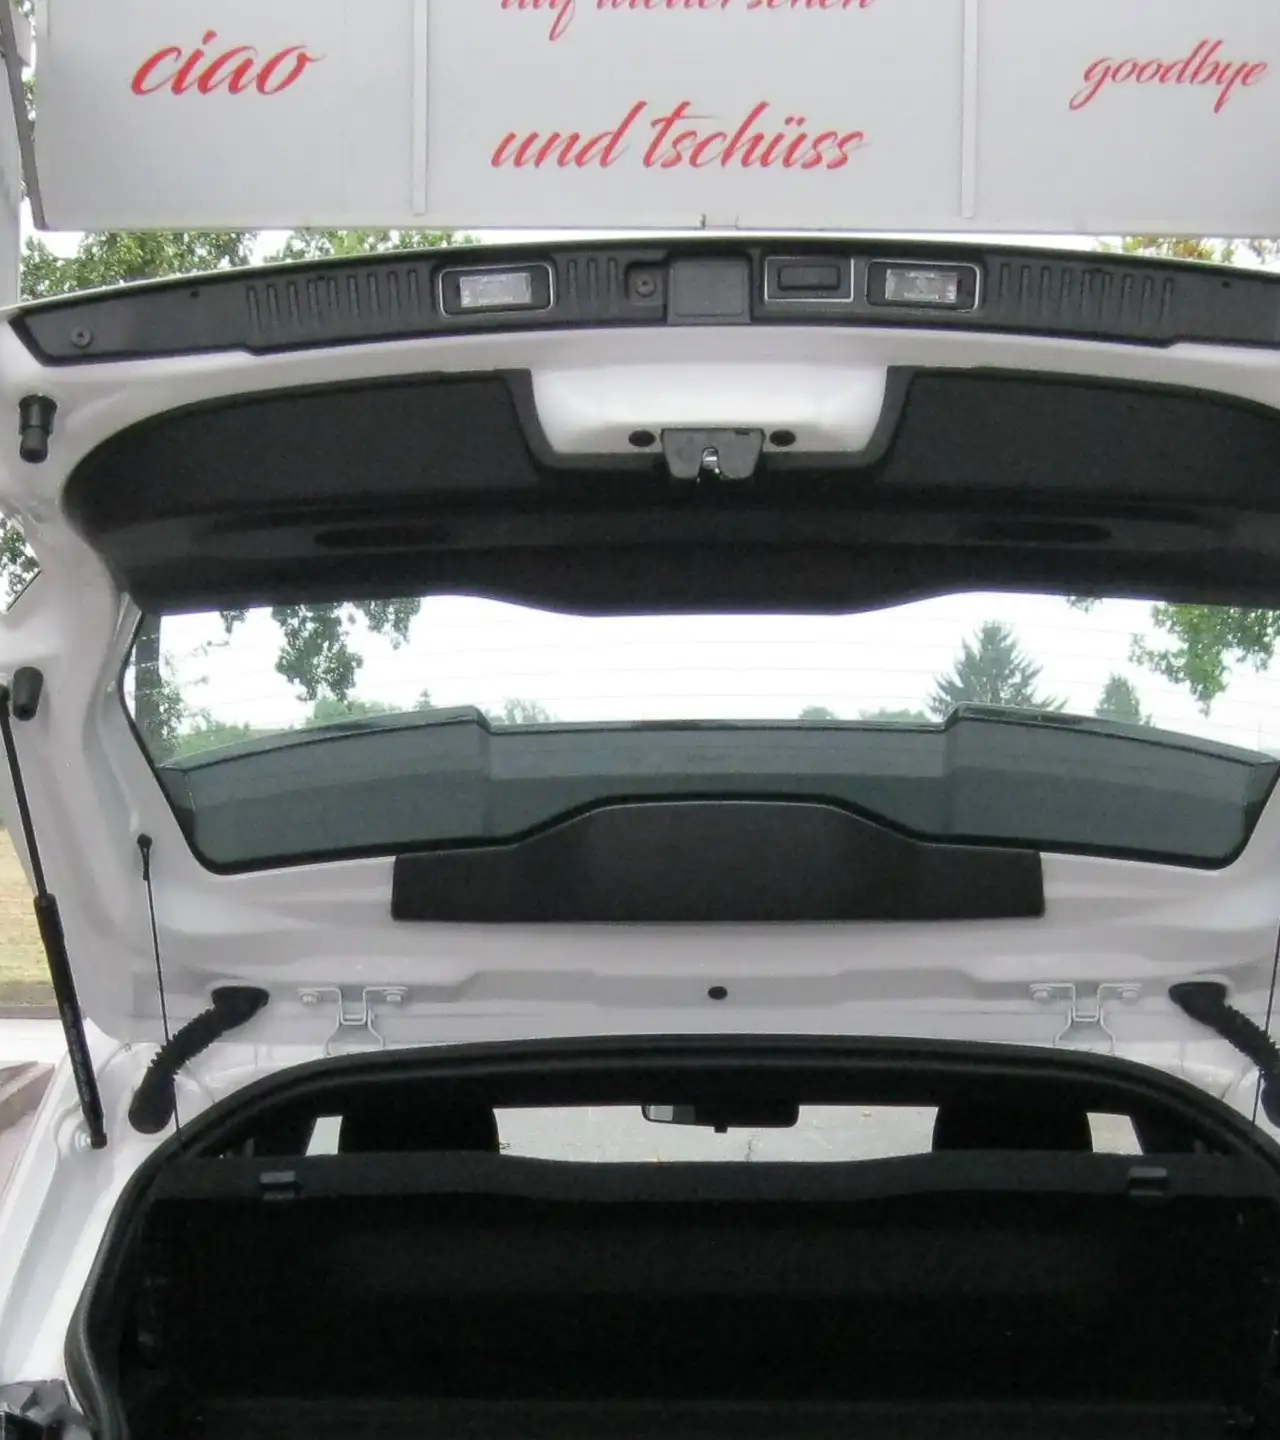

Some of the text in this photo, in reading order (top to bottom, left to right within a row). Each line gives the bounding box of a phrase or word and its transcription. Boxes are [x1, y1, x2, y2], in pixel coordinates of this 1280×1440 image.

[130, 29, 327, 95] ciao
[1069, 39, 1268, 113] goodbye
[490, 100, 868, 169] und tschüss
